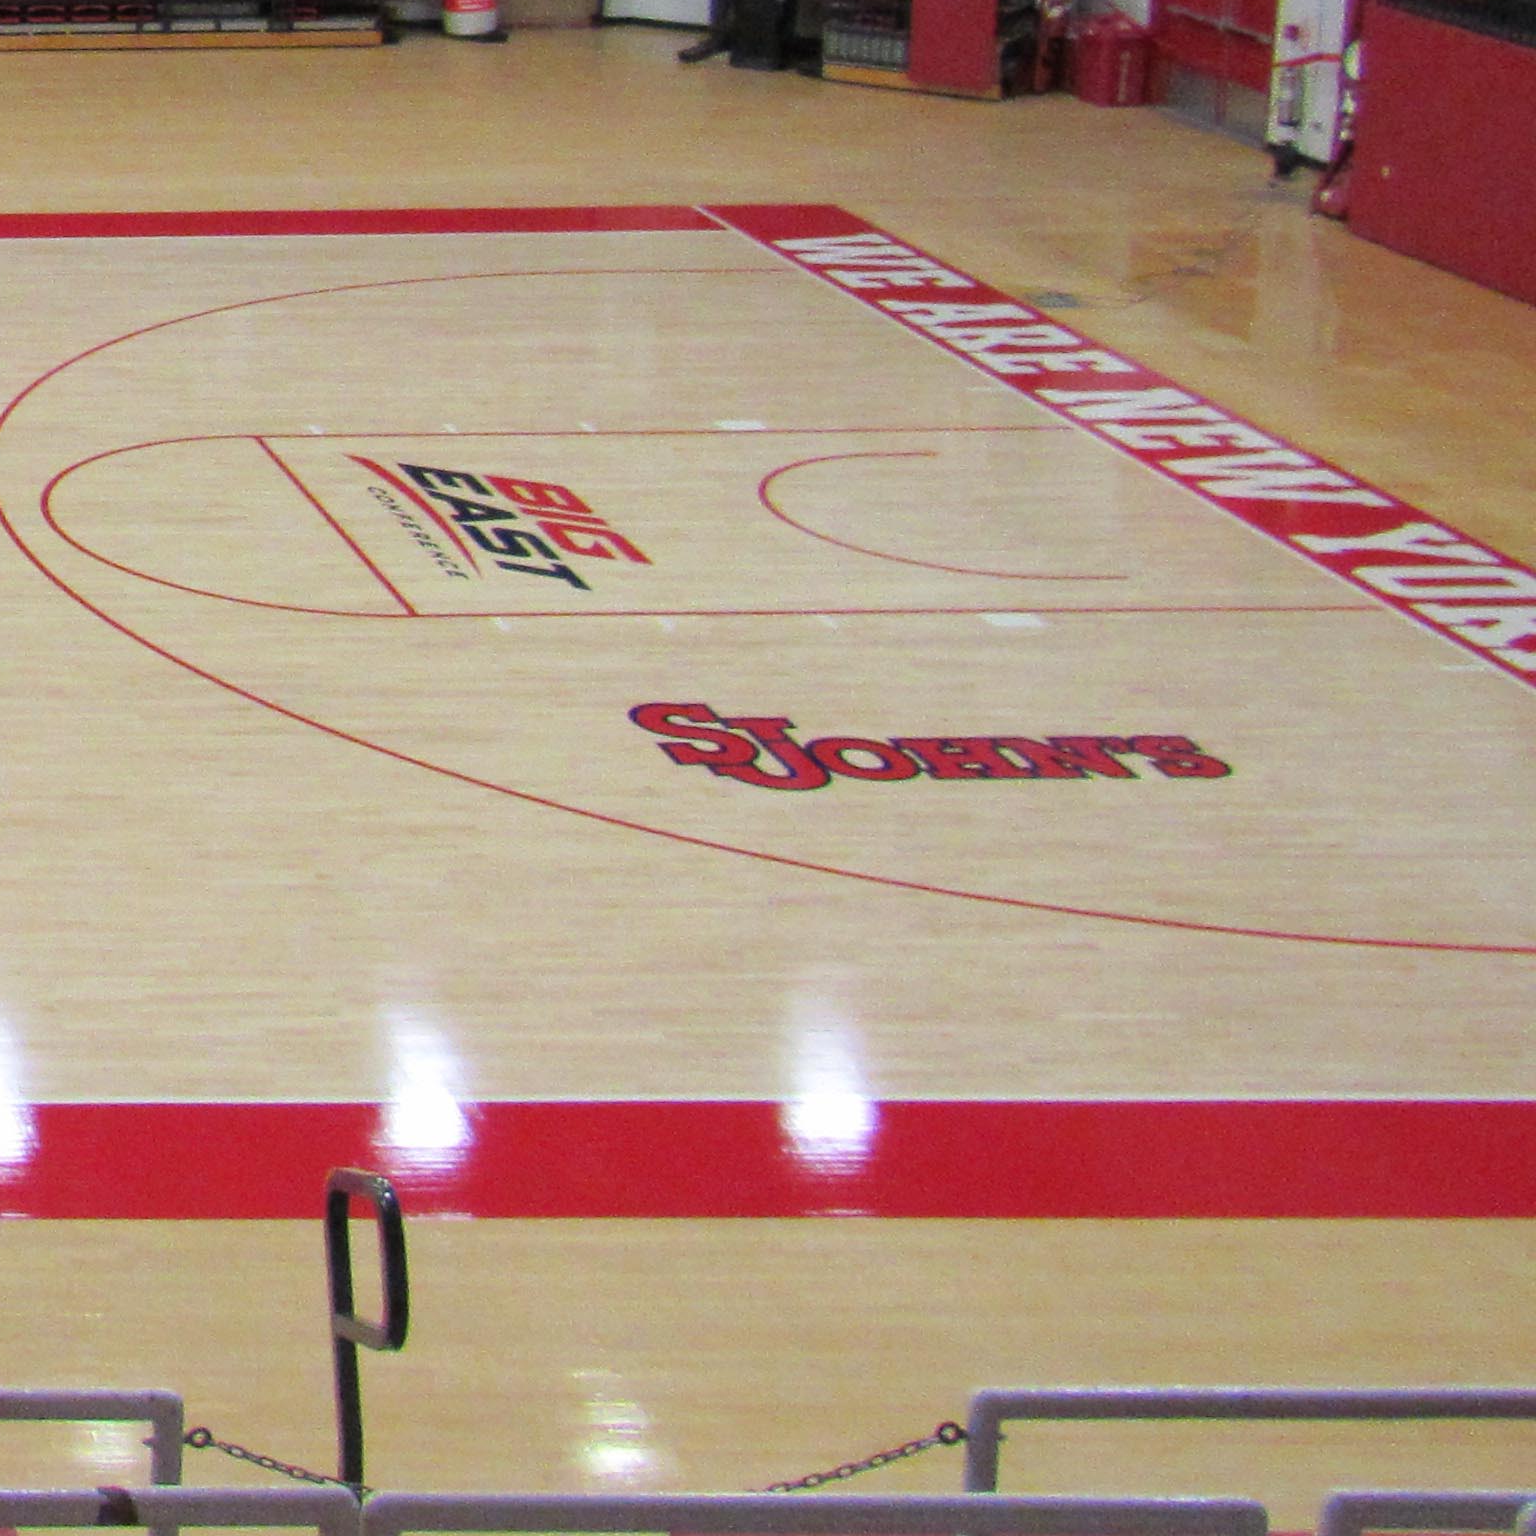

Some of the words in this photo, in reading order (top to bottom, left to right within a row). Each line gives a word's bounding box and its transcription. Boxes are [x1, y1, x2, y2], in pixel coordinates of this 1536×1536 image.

[775, 232, 975, 290] WE
[891, 299, 1140, 376] ARE
[1034, 386, 1395, 507] NEW
[1288, 521, 1536, 670] YOR
[367, 485, 469, 581] CONFERENCE
[396, 463, 592, 591] EAST
[484, 474, 654, 565] BIG
